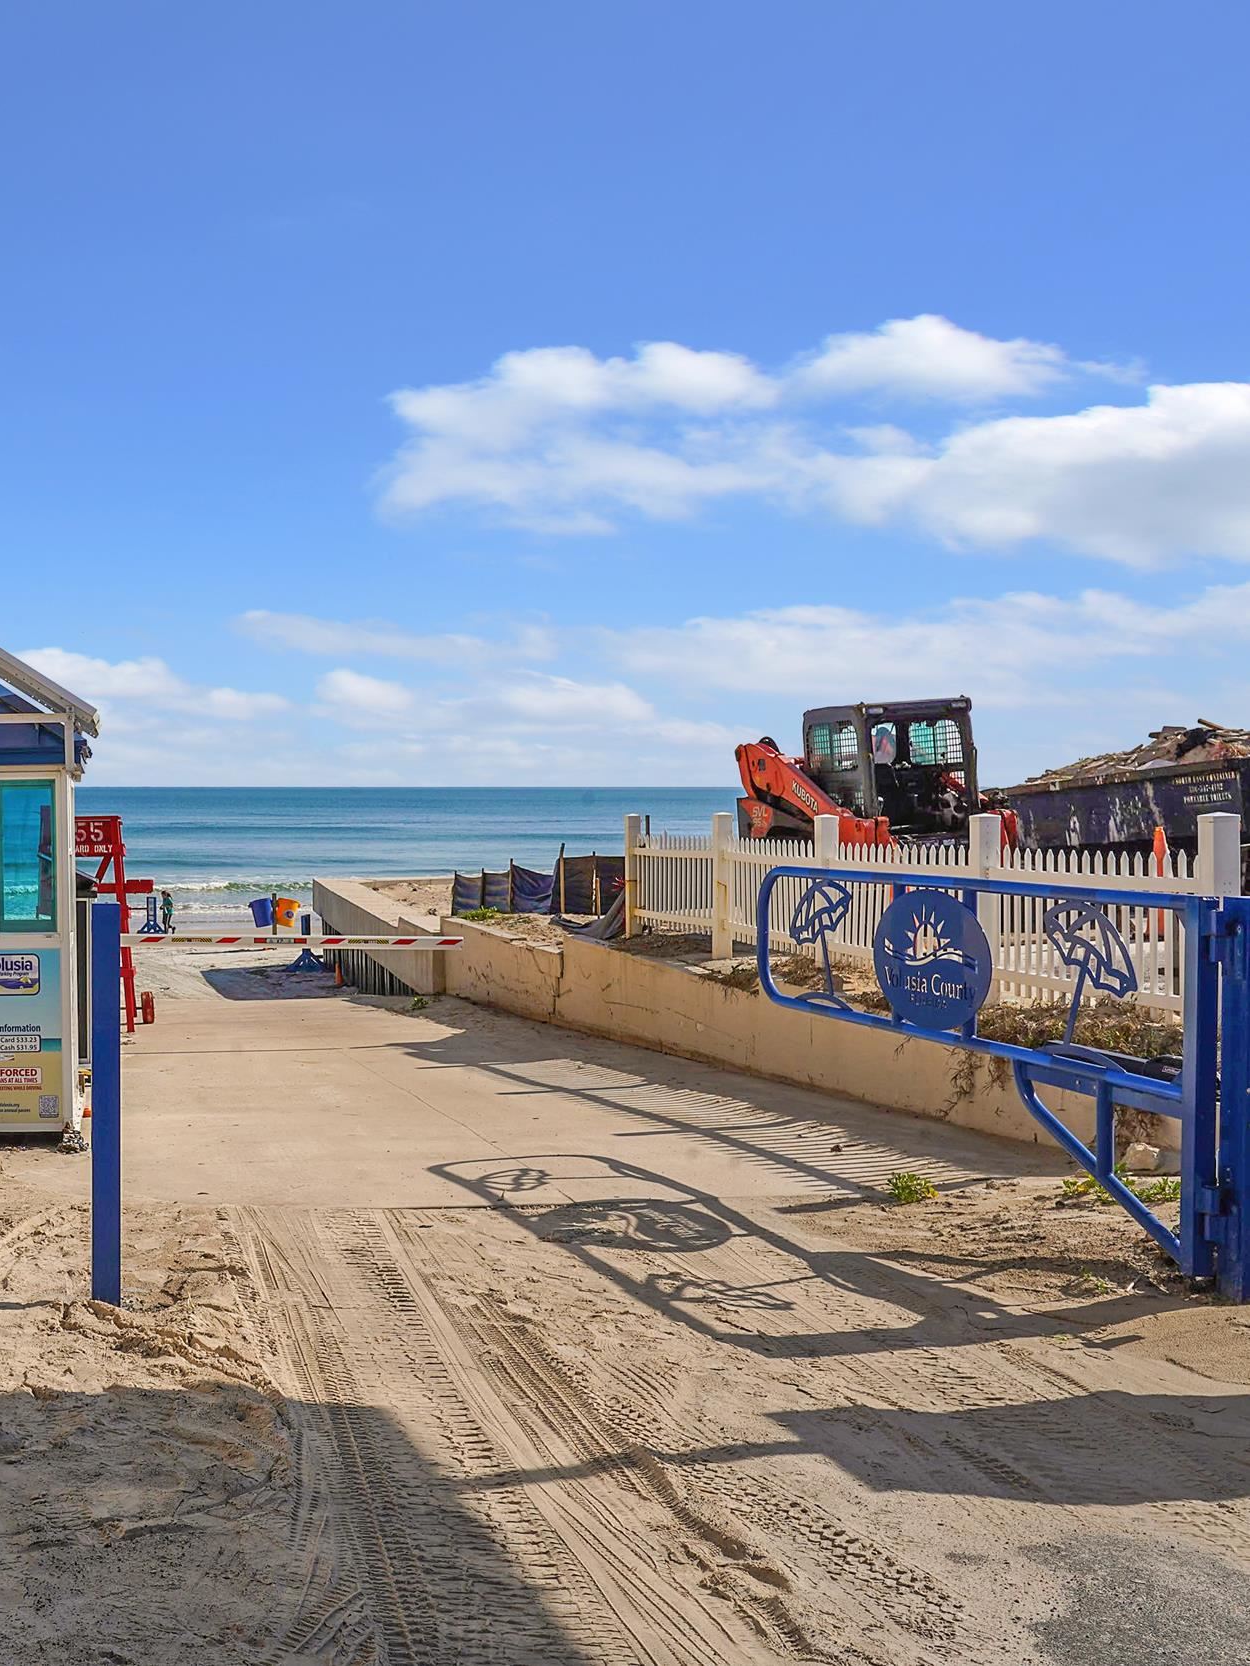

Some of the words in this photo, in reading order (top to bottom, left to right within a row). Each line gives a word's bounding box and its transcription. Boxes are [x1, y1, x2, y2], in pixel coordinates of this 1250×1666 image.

[791, 779, 818, 813] KUBOTA
[94, 844, 113, 853] ONLY
[884, 965, 928, 994] Volusia
[931, 973, 977, 1008] County
